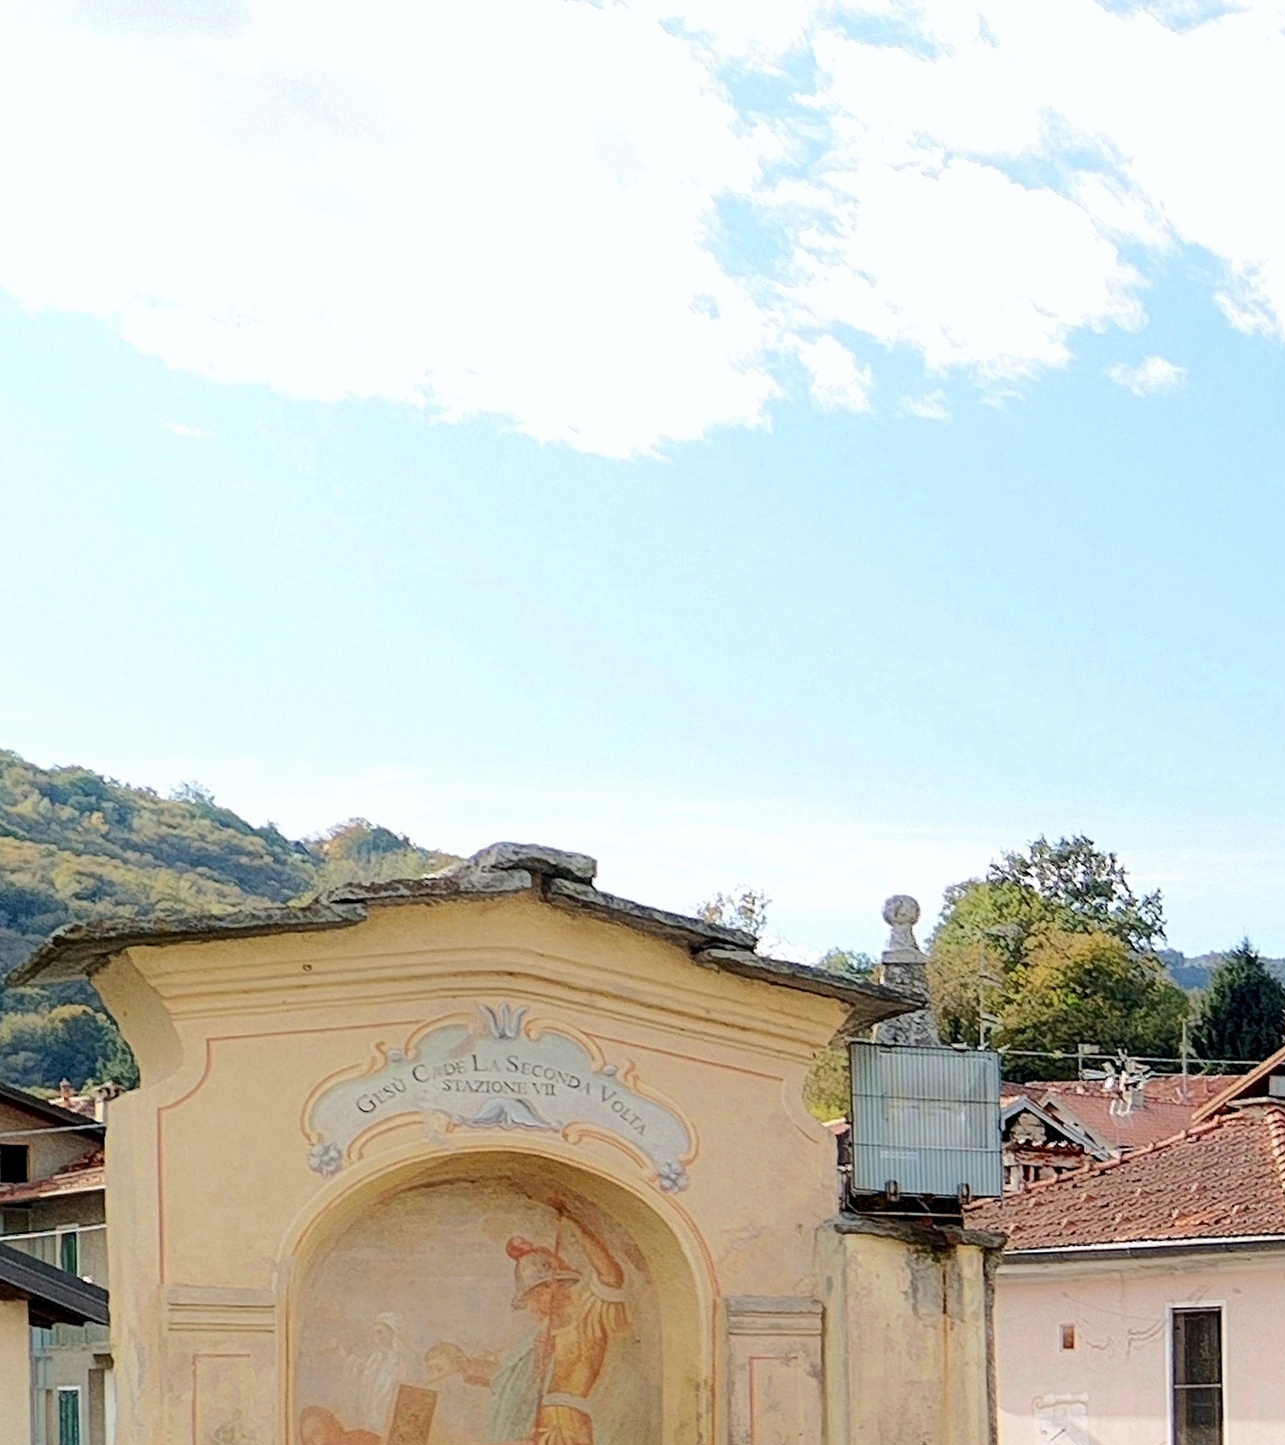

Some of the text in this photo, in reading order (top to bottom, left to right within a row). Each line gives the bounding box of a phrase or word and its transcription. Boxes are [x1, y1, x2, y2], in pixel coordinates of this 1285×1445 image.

[442, 1080, 556, 1097] STAZIONE VII
[472, 1054, 500, 1072] LA
[506, 1054, 590, 1095] SECONDA
[601, 1084, 646, 1135] VOLTA
